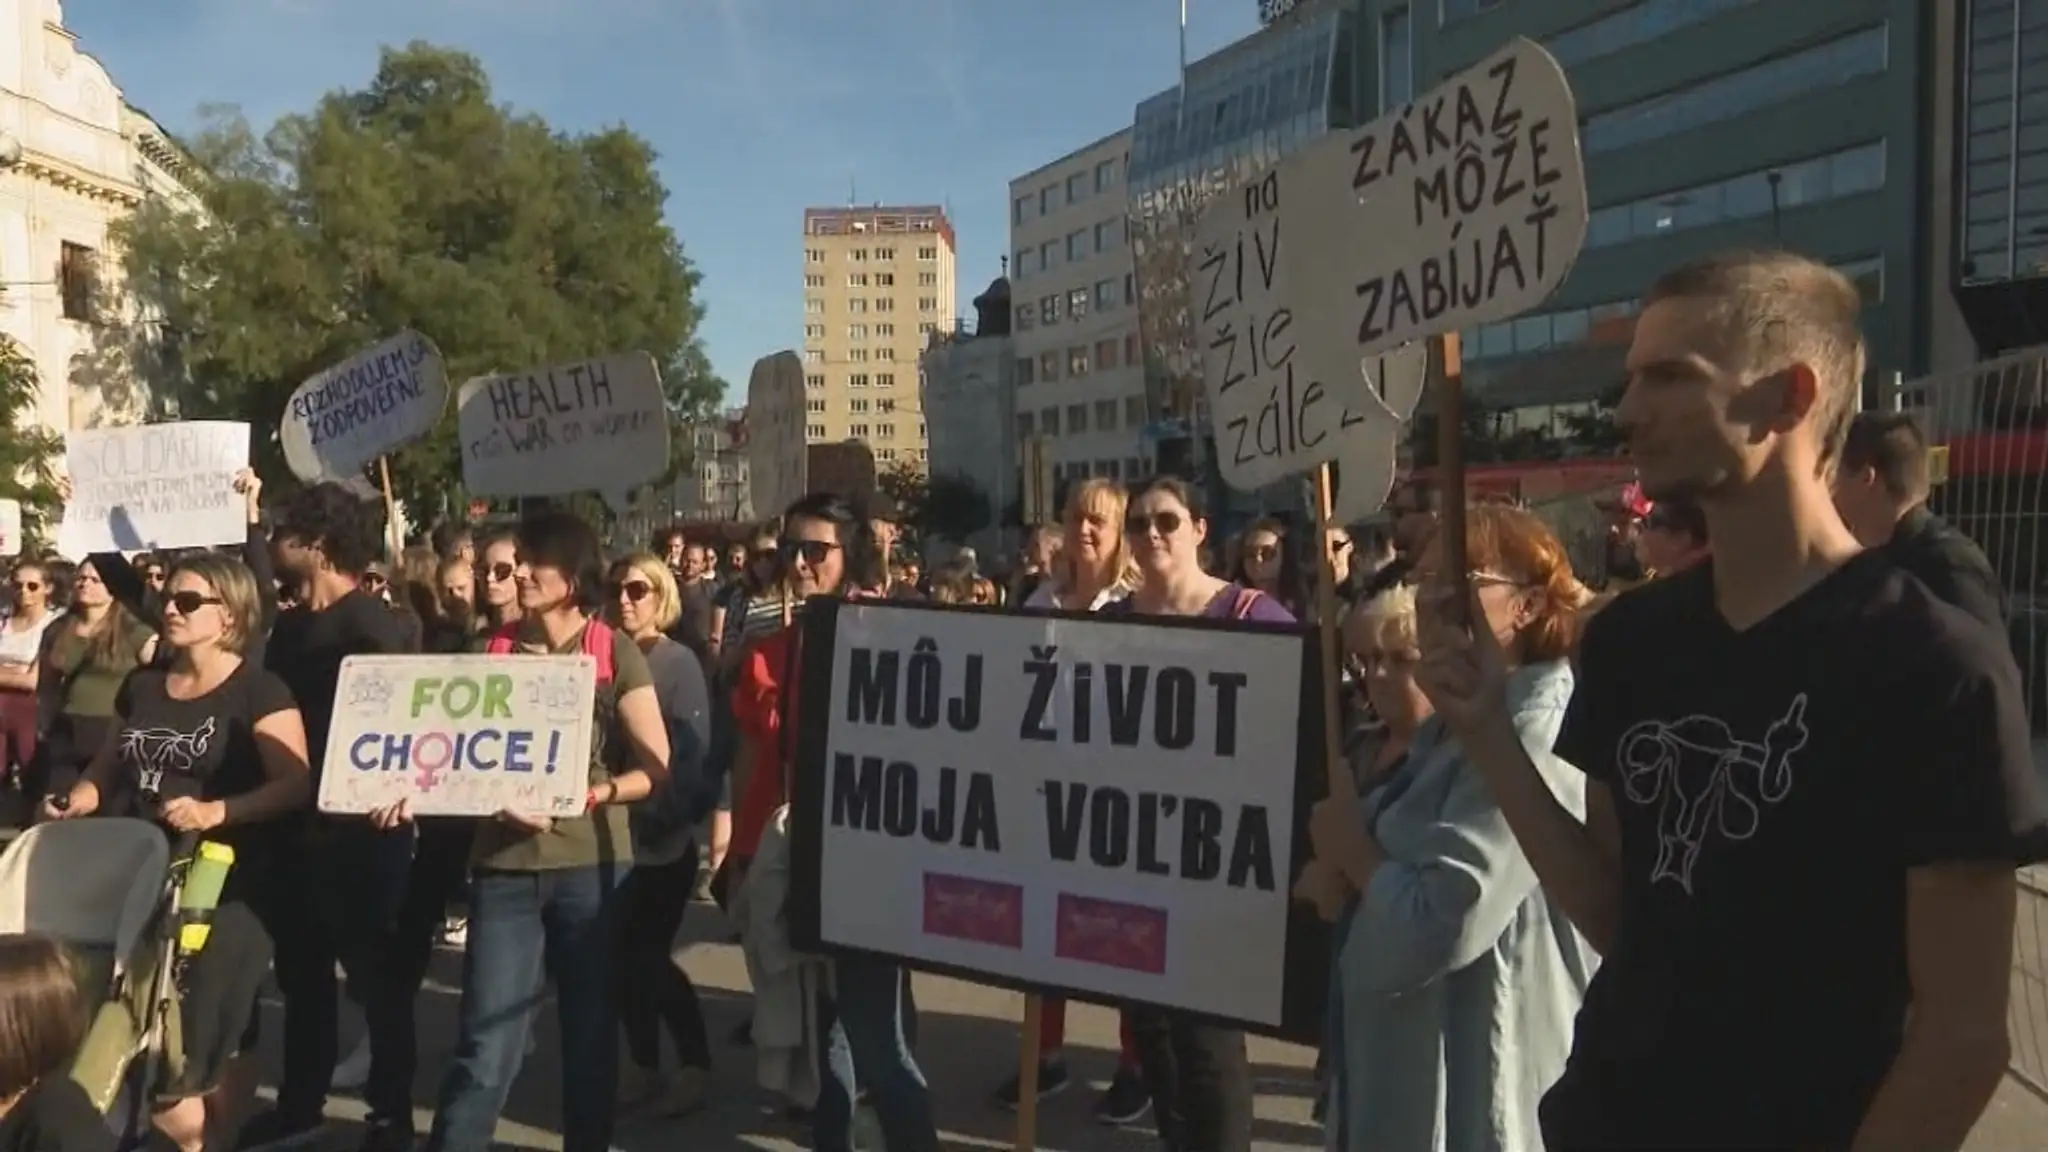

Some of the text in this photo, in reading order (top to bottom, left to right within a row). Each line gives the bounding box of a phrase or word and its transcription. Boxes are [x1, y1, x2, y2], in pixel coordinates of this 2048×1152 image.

[1350, 56, 1523, 191] ZÁKAZ
[1413, 119, 1563, 227] MÔŽE
[1246, 169, 1279, 221] na
[1356, 191, 1559, 344] ZABÍJAŤ
[487, 362, 614, 422] HEALTH
[504, 415, 557, 453] WAR
[410, 674, 513, 718] FOR
[846, 636, 1248, 758] MÔJ ŽIVOT
[831, 751, 1276, 892] MOJA VOĽBA
